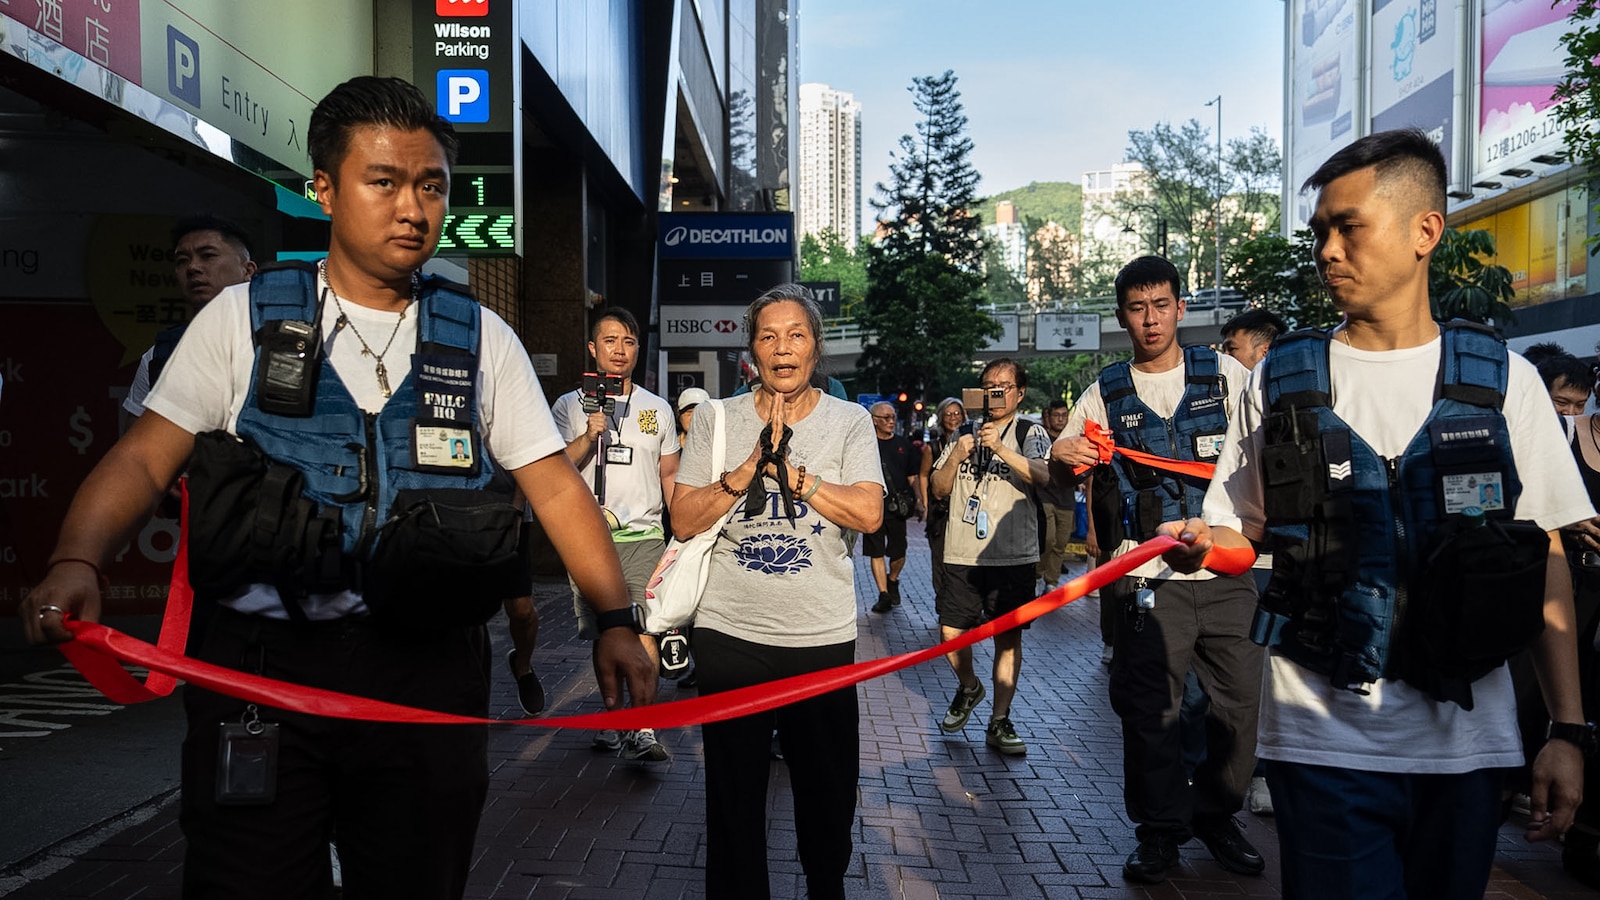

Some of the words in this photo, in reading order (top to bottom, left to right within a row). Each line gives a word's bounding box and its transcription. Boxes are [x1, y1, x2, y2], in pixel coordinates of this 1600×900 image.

[434, 23, 491, 38] Wilson
[435, 42, 489, 59] Parking
[448, 76, 481, 116] P
[222, 75, 269, 136] Entry
[471, 176, 484, 206] 1
[689, 229, 788, 244] DECATHLON
[129, 243, 176, 262] Wee
[130, 272, 179, 288] New
[667, 320, 712, 334] HSBC
[424, 392, 466, 408] FMLC
[433, 405, 456, 420] HQ
[1121, 412, 1143, 423] FMLC
[1126, 420, 1139, 429] HQ
